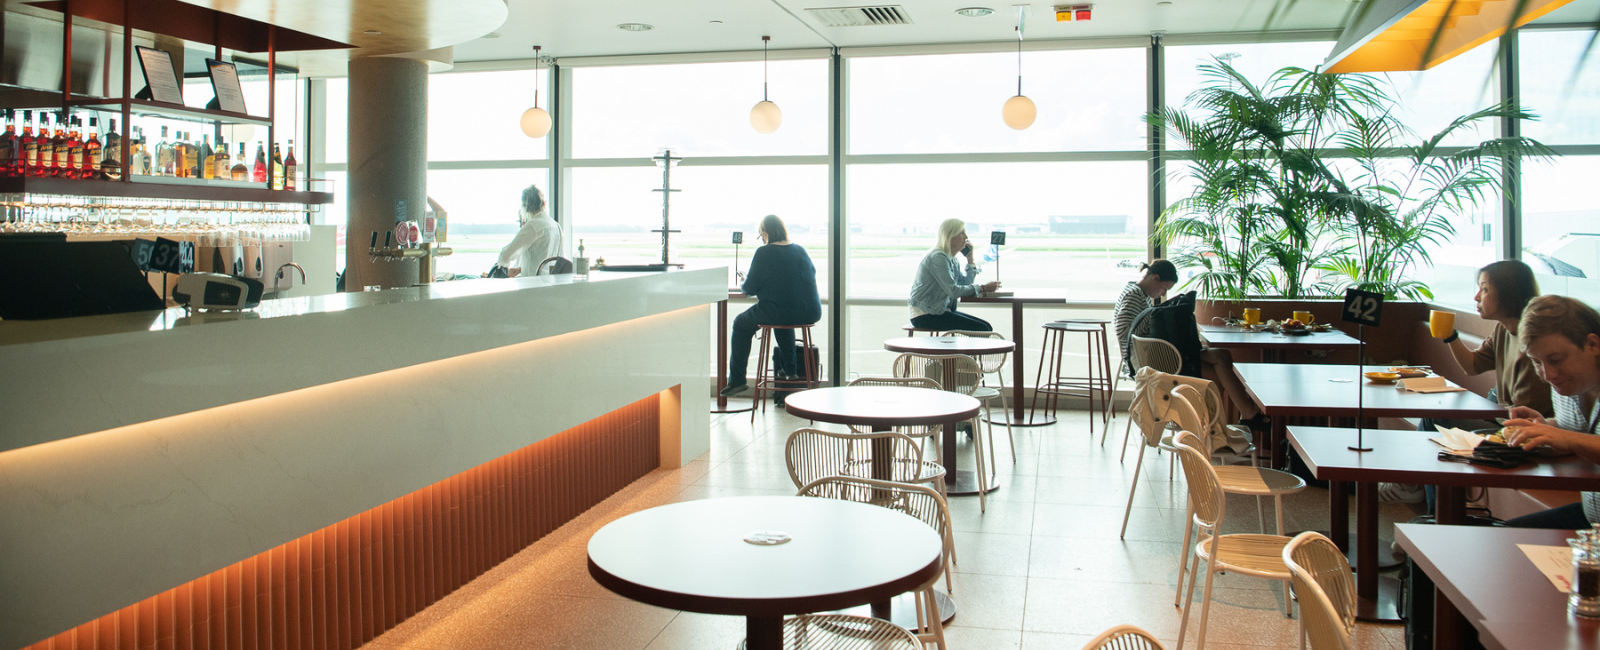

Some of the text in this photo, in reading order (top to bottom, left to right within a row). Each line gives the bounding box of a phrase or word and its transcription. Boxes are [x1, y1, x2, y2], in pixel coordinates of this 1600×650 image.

[734, 233, 742, 243] 48
[992, 232, 1004, 243] 27
[155, 243, 179, 268] 37
[1348, 295, 1377, 321] 42
